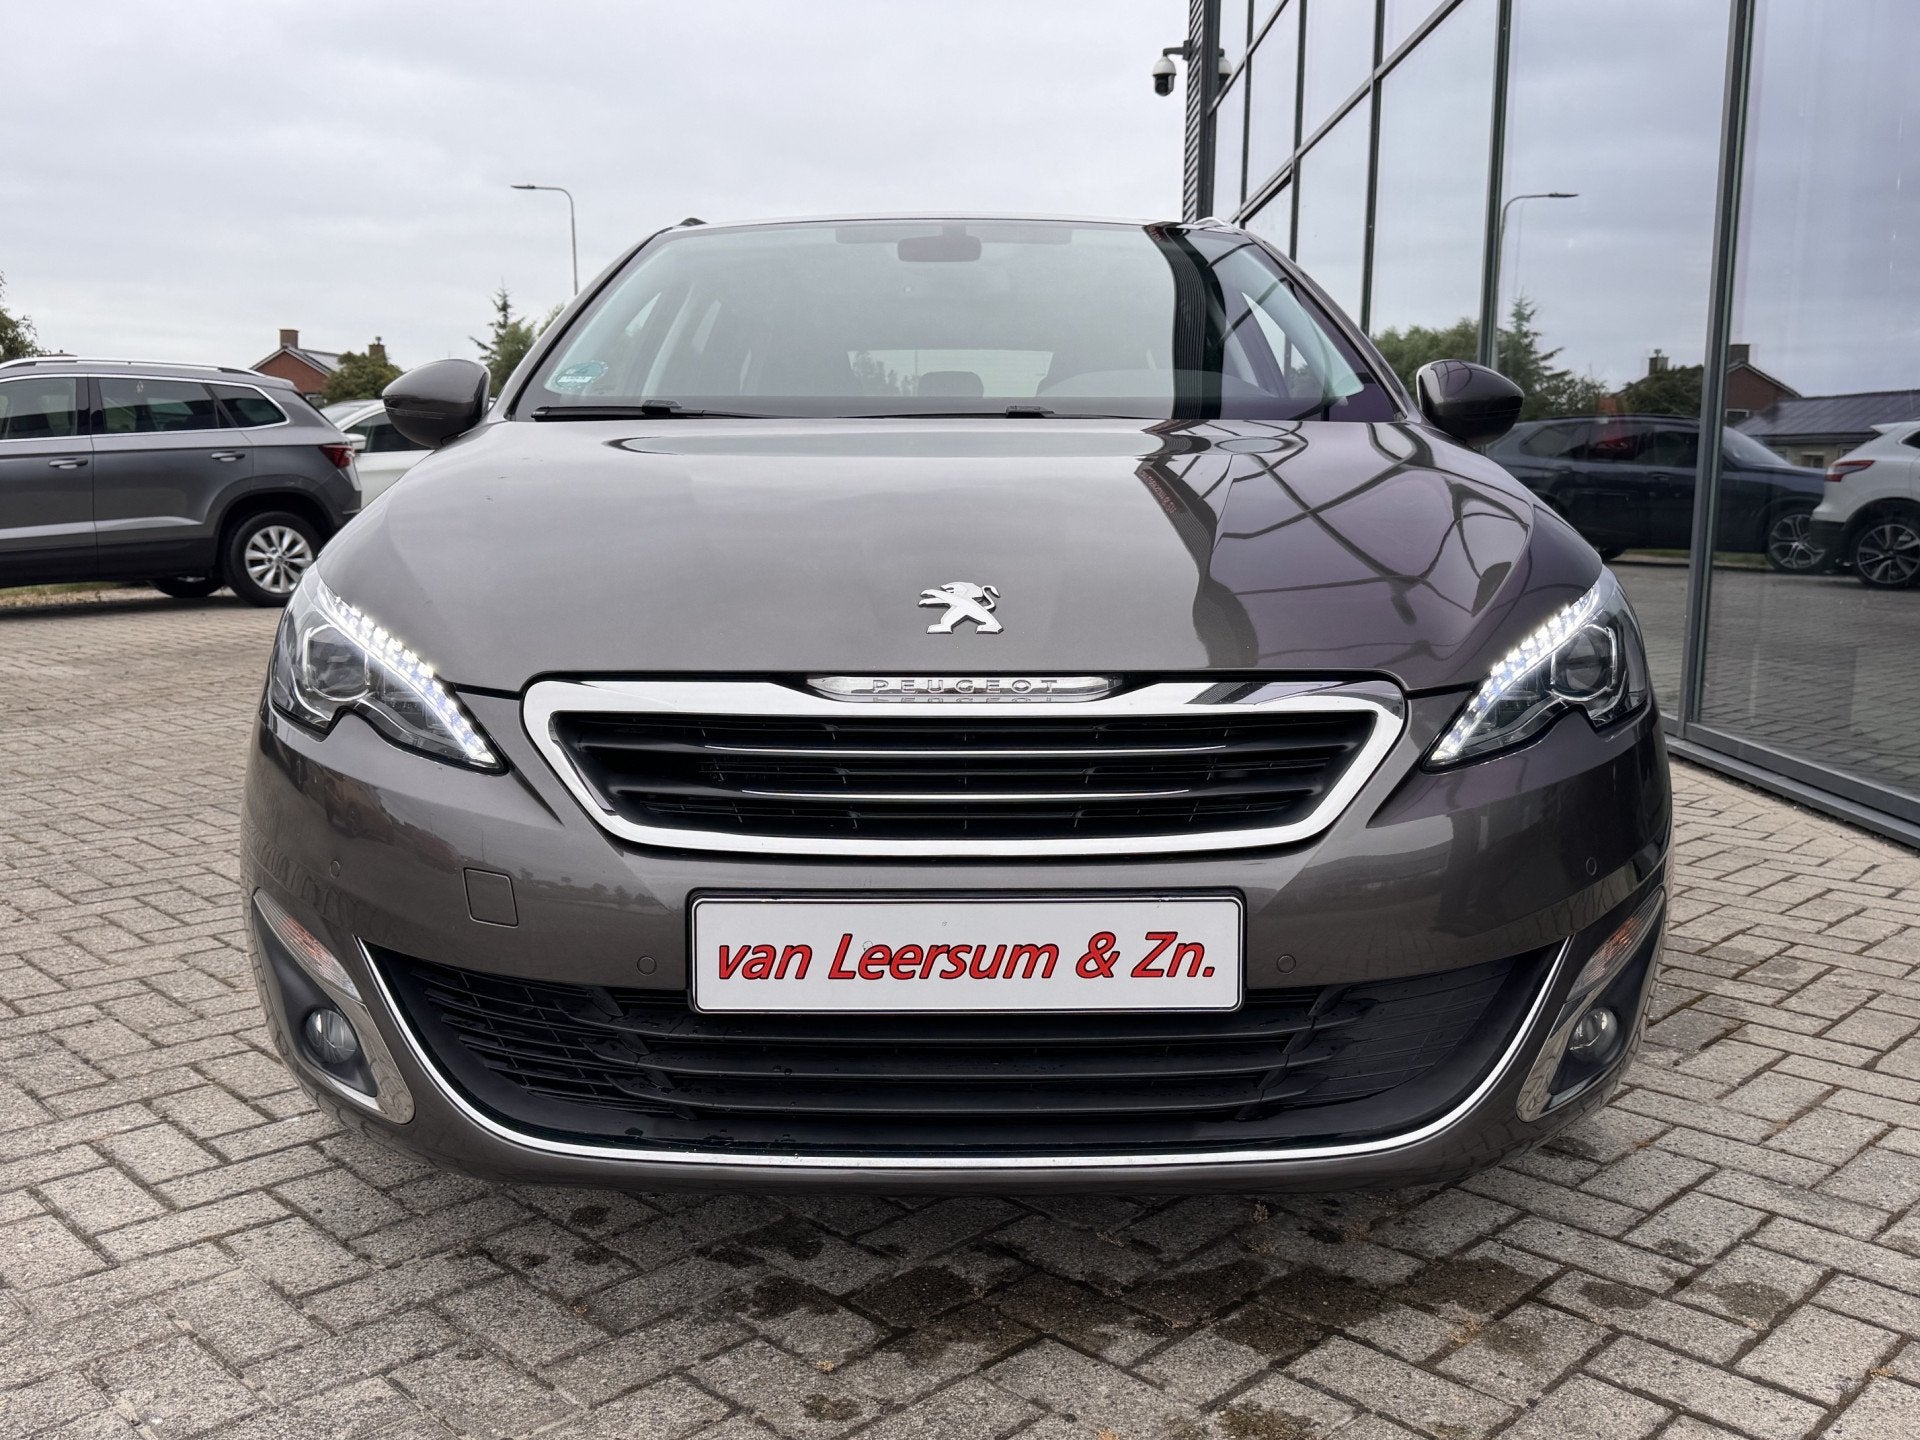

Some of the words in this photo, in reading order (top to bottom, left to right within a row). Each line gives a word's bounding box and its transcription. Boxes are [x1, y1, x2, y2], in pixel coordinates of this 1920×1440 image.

[872, 679, 1058, 694] PEUGEOT
[718, 944, 813, 980] van
[827, 933, 1060, 980] Leersum
[1075, 931, 1121, 979] &
[1130, 931, 1216, 978] Zn.
